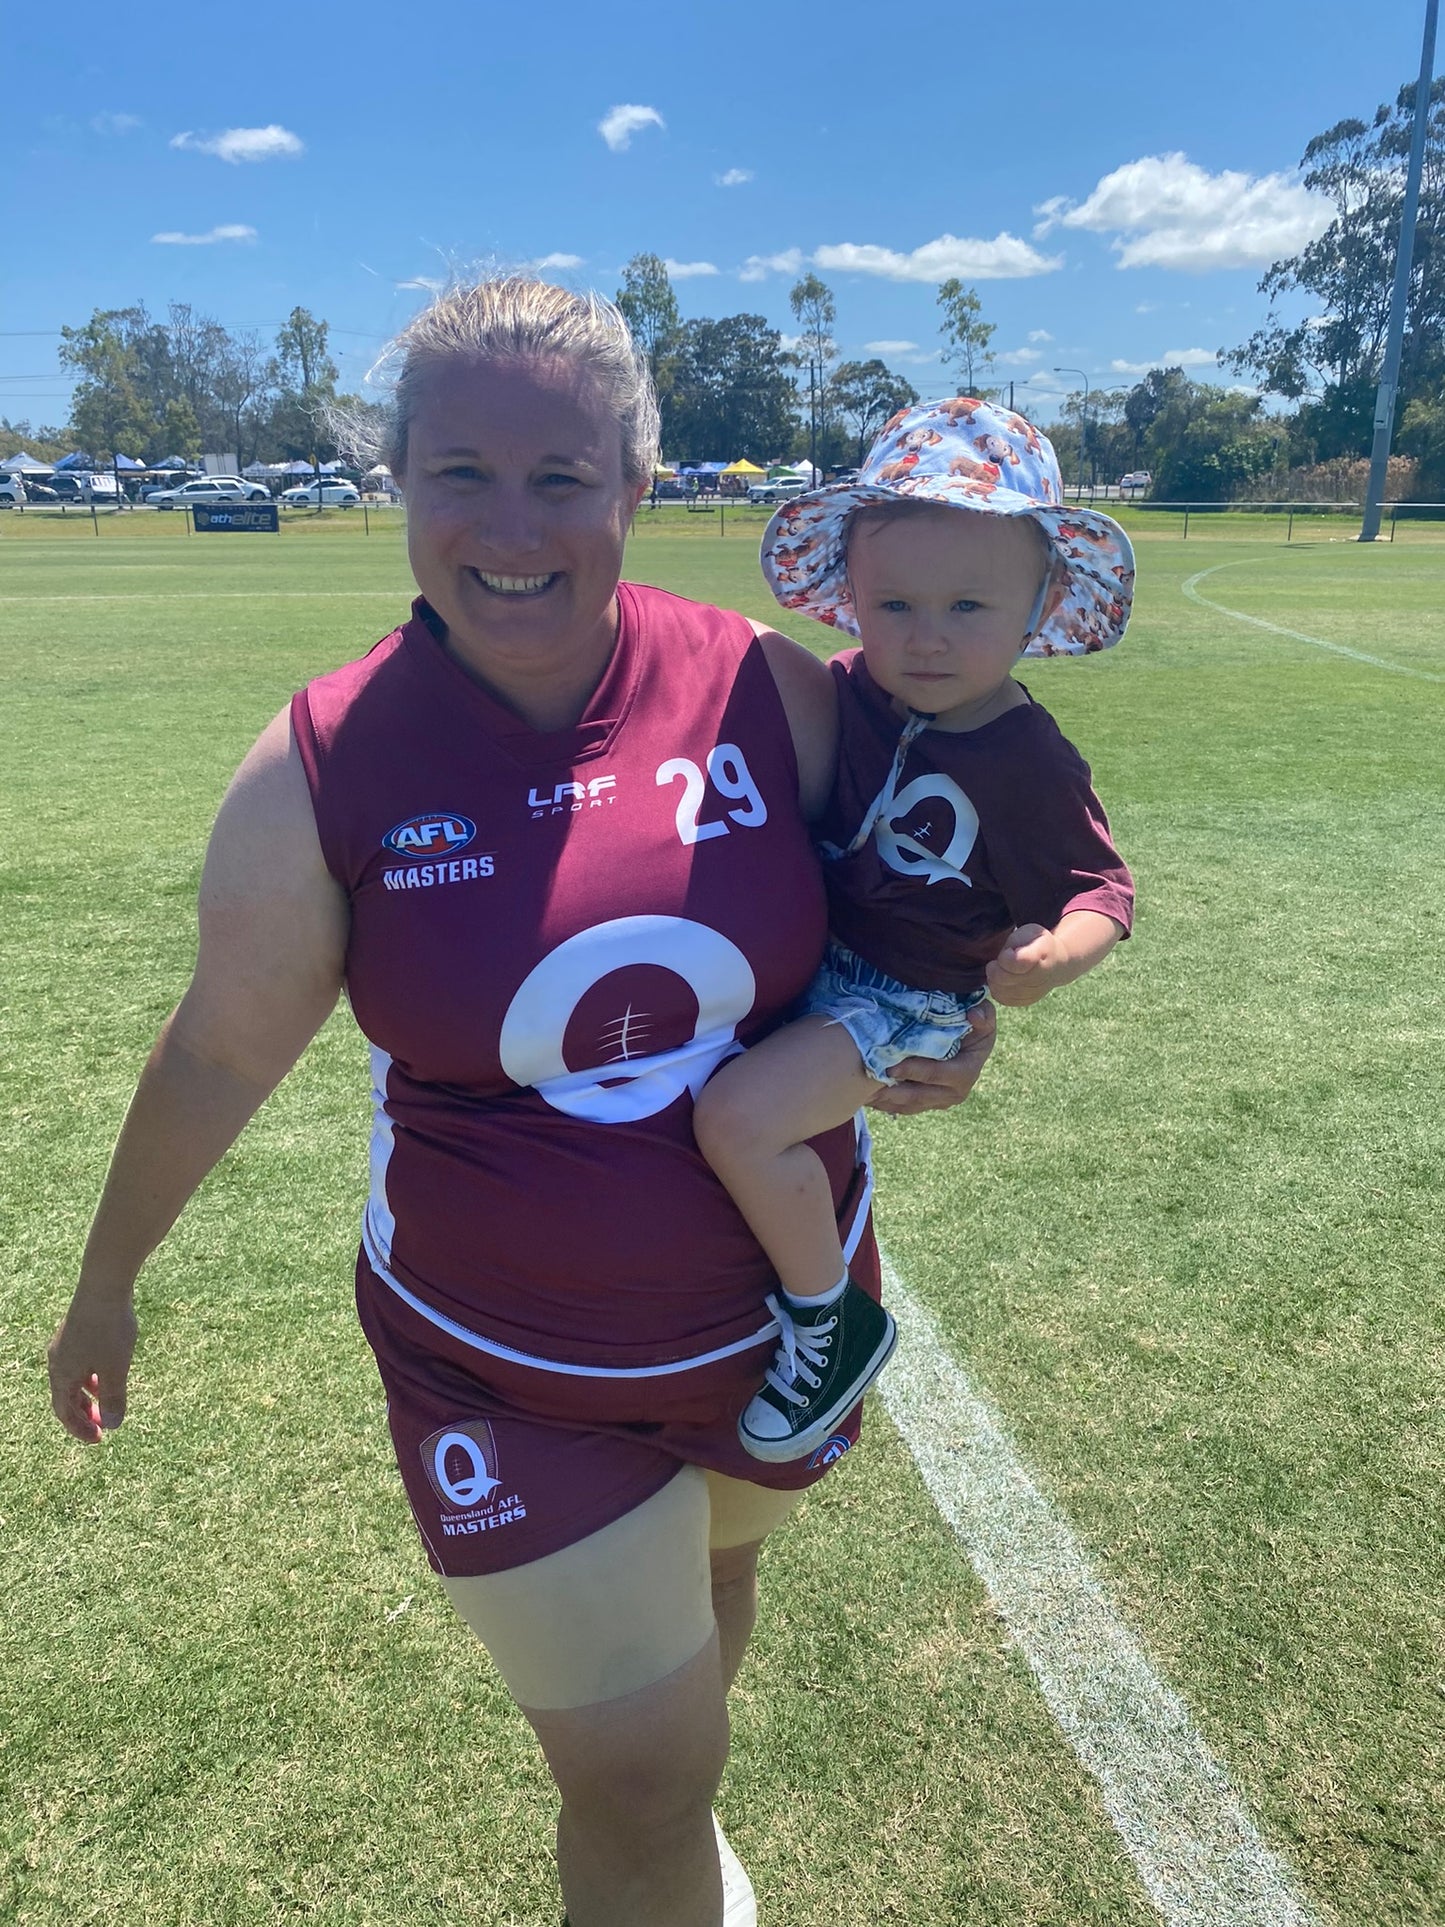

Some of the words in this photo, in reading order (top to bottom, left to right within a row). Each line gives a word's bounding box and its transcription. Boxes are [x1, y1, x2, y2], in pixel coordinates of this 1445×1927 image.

[210, 511, 272, 525] athelite
[528, 775, 616, 807] LRF
[656, 743, 768, 846] 29
[531, 796, 616, 819] SPORT
[396, 820, 469, 848] AFL
[383, 856, 495, 890] MASTERS
[434, 1431, 503, 1506] Q
[440, 1504, 494, 1522] Queensland
[498, 1494, 522, 1511] AFL
[442, 1505, 527, 1536] MASTERS
